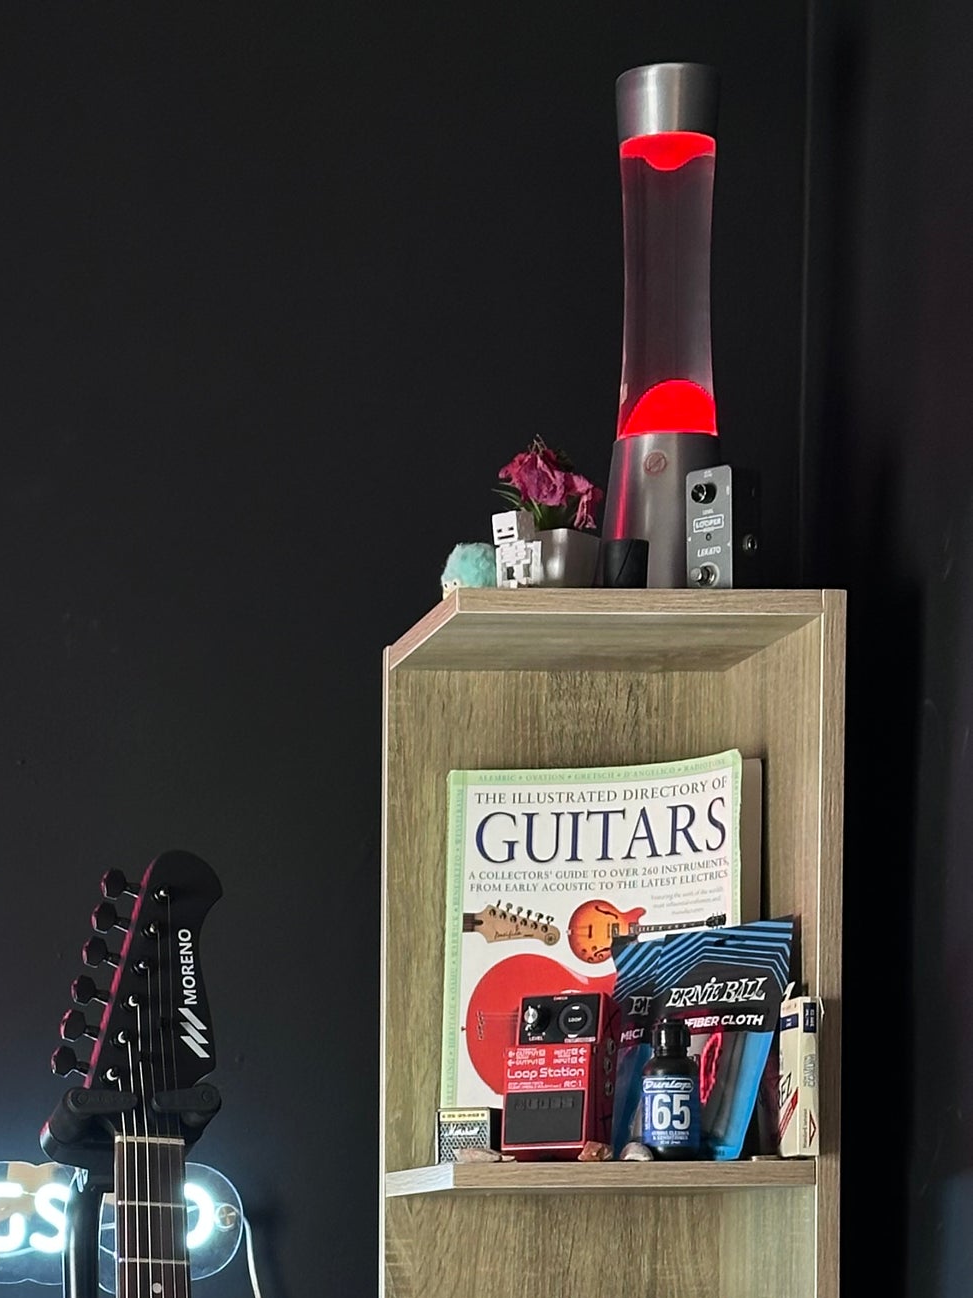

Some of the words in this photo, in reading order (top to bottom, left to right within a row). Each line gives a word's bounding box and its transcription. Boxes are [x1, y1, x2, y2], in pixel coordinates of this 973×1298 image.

[474, 792, 506, 805] THE
[512, 790, 617, 805] ILLUSTRATED
[622, 781, 709, 801] DIRECTORY
[712, 776, 728, 790] OF
[476, 796, 727, 864] GUITARS
[468, 871, 477, 880] A
[478, 871, 553, 880] COLLECTORS'
[555, 870, 589, 879] GUIDE
[593, 869, 608, 878] TO
[609, 868, 639, 877] OVER
[642, 867, 659, 876] 260
[470, 882, 502, 892] FROM
[504, 882, 539, 892] EARLY
[541, 881, 596, 891] ACOUSTIC
[599, 881, 614, 890] TO
[617, 880, 638, 890] THE
[641, 876, 677, 889] LATEST
[679, 870, 728, 885] ELECTRICS
[178, 928, 198, 1005] MORENO
[665, 977, 724, 1008] ERNIE
[720, 977, 768, 1003] BALL
[684, 1016, 720, 1029] FIBER
[720, 1014, 764, 1026] CLOTH
[507, 1068, 538, 1080] Loop
[539, 1067, 584, 1078] Station
[644, 1080, 692, 1091] Dunlop
[652, 1093, 691, 1130] 65
